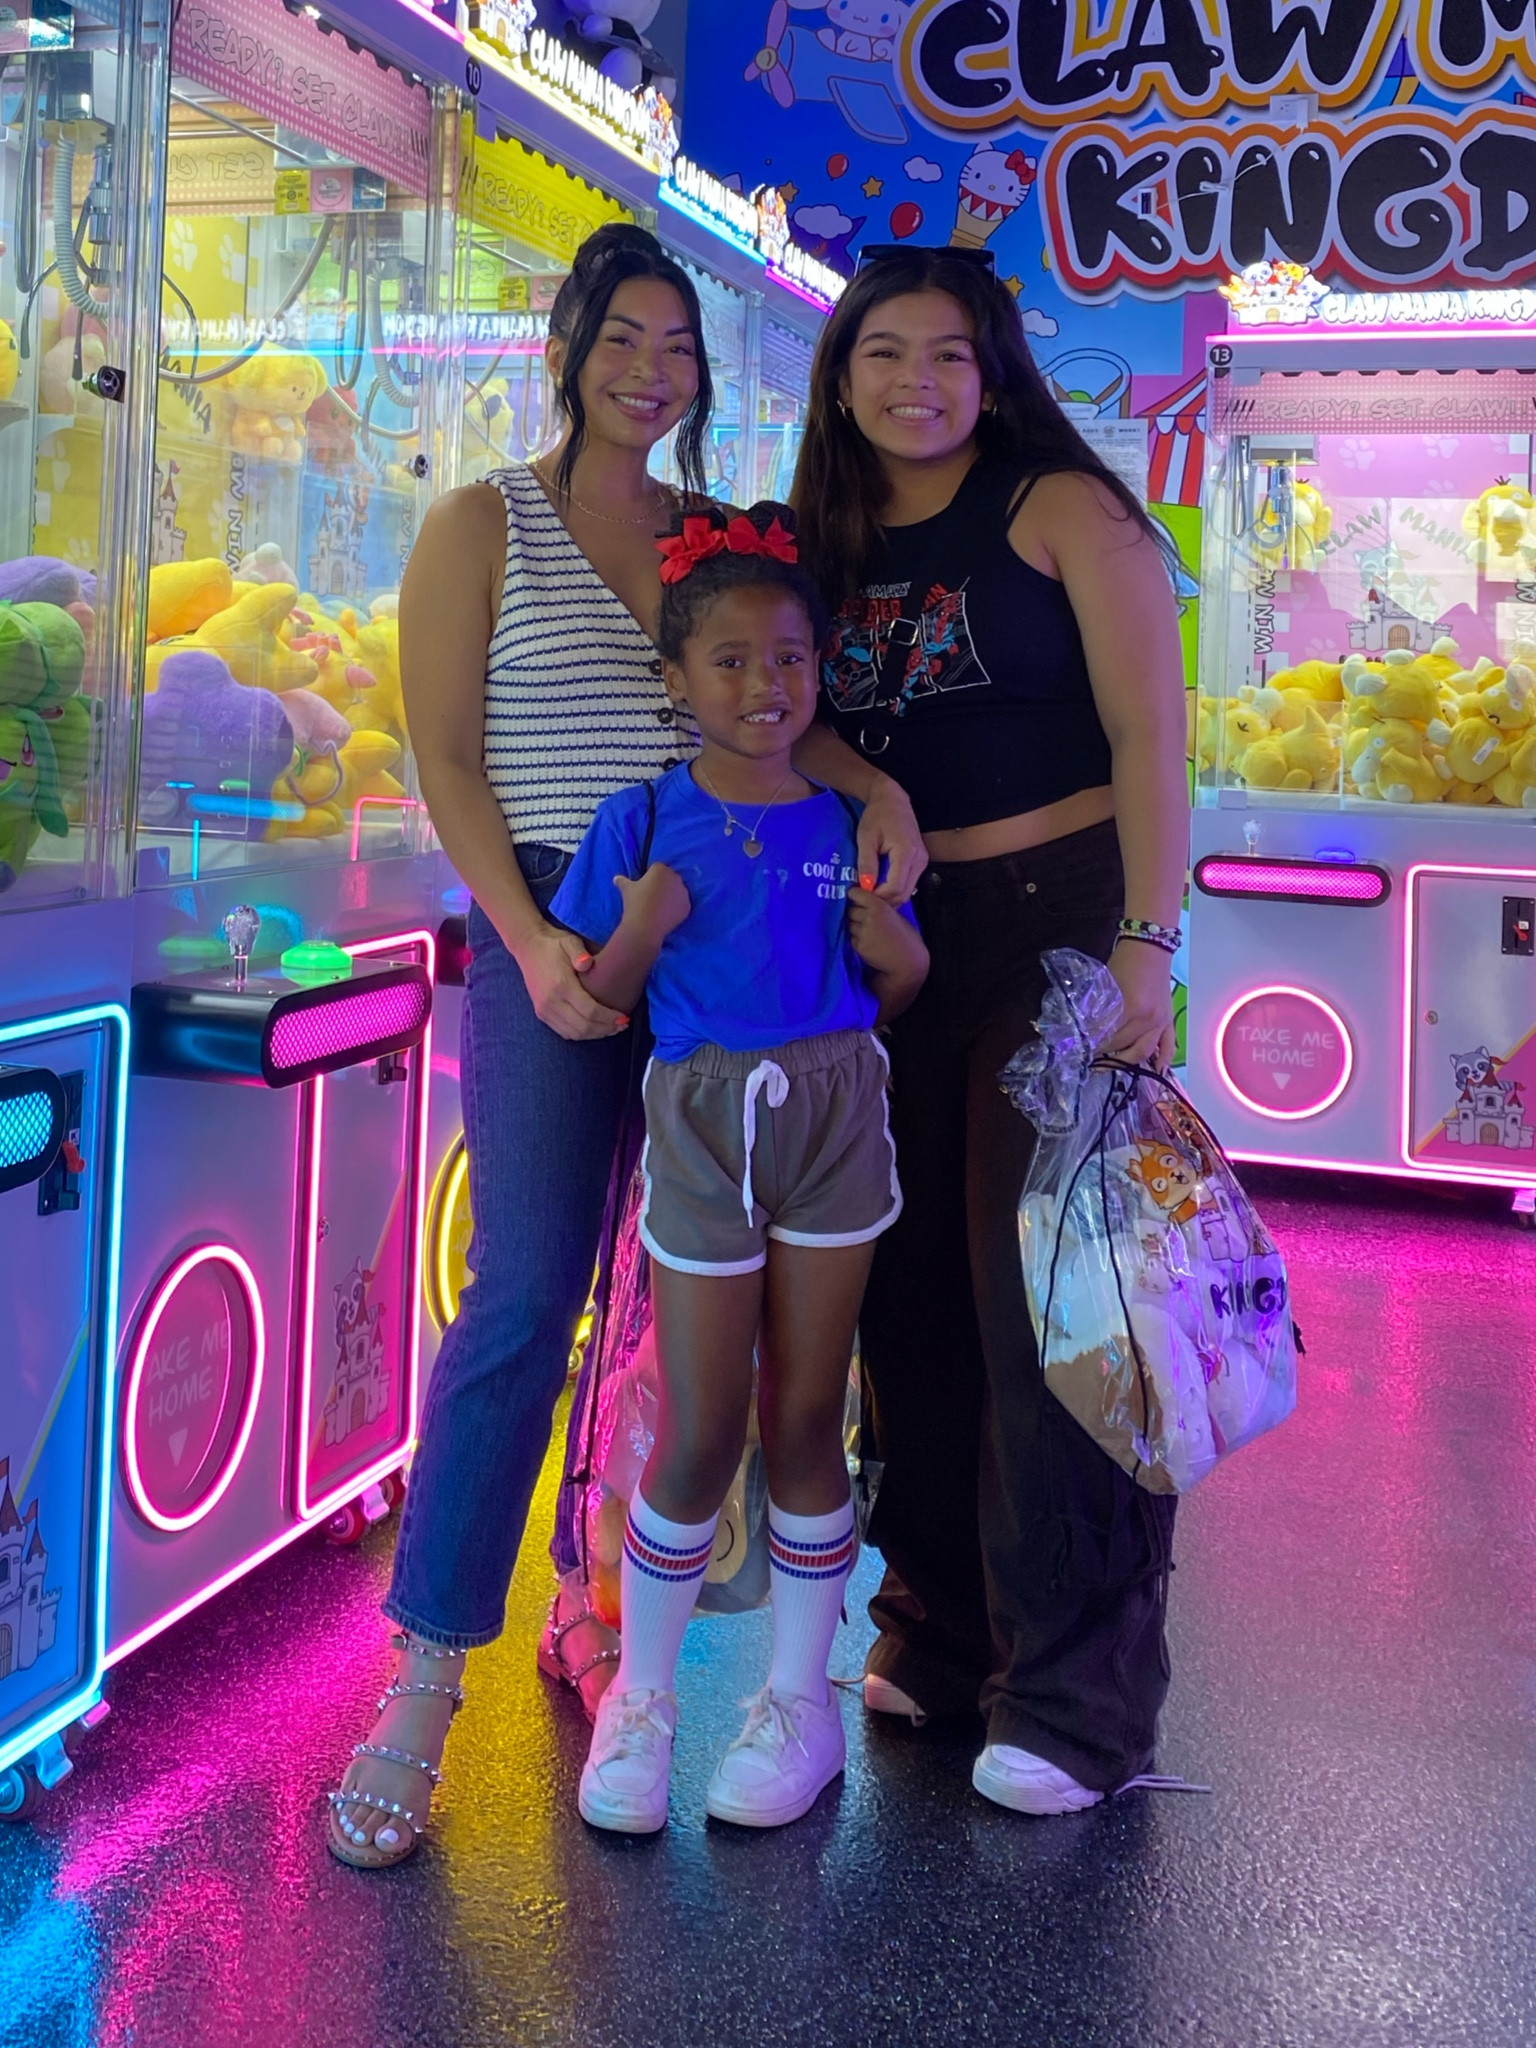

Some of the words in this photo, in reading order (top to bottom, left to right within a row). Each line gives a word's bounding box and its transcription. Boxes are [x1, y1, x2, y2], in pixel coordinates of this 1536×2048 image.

[189, 9, 284, 90] READY?
[292, 67, 335, 120] SET
[920, 0, 1377, 108] CLAW
[468, 62, 480, 88] 10
[482, 172, 545, 228] READY?
[550, 207, 577, 247] SET
[1323, 293, 1388, 323] CLAW
[1388, 292, 1466, 322] MANIA
[1213, 349, 1230, 363] 13
[1260, 399, 1361, 421] READY?
[1371, 399, 1425, 419] SET
[1254, 604, 1275, 655] WIN
[803, 862, 835, 880] COOL
[817, 883, 846, 900] CLUB
[1237, 1026, 1291, 1046] TAKE
[1302, 1031, 1335, 1050] ME
[147, 1336, 191, 1388] AKE
